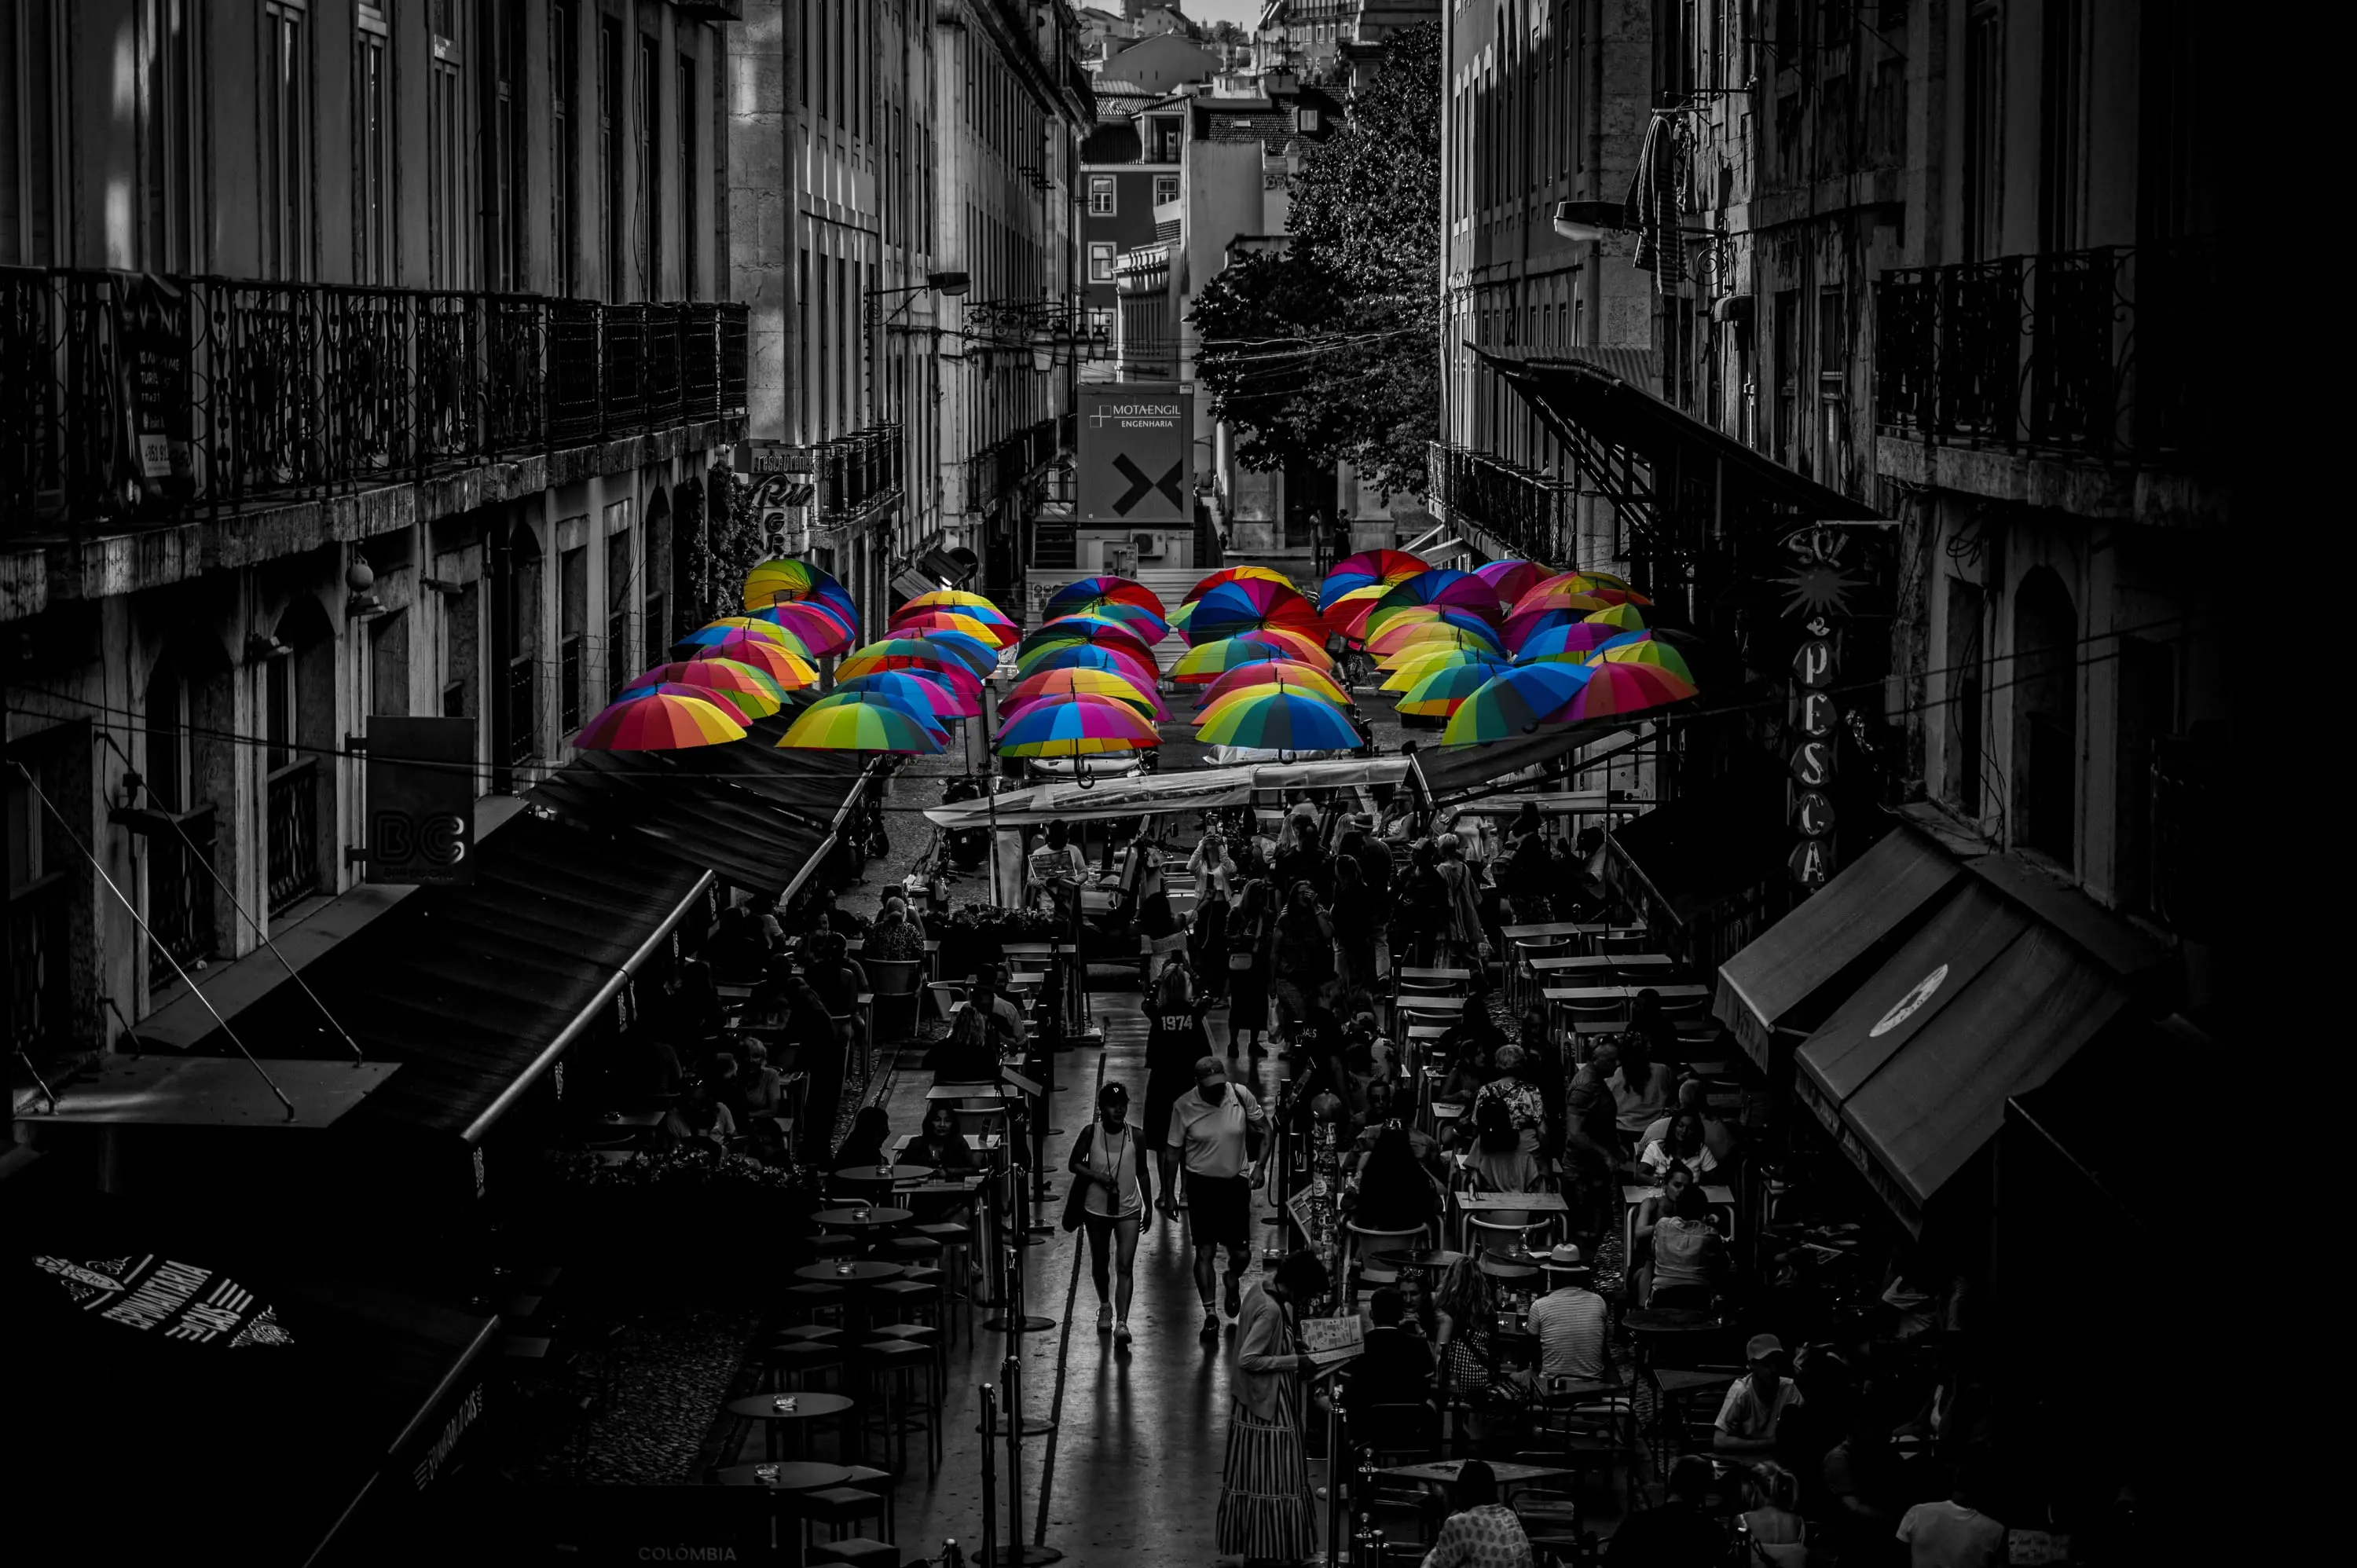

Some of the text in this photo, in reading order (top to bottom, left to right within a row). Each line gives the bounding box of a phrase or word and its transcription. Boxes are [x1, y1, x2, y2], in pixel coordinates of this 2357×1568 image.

[747, 473, 815, 507] Rio
[1160, 1014, 1193, 1031] 1974
[637, 1542, 738, 1563] COLÔMBIA
